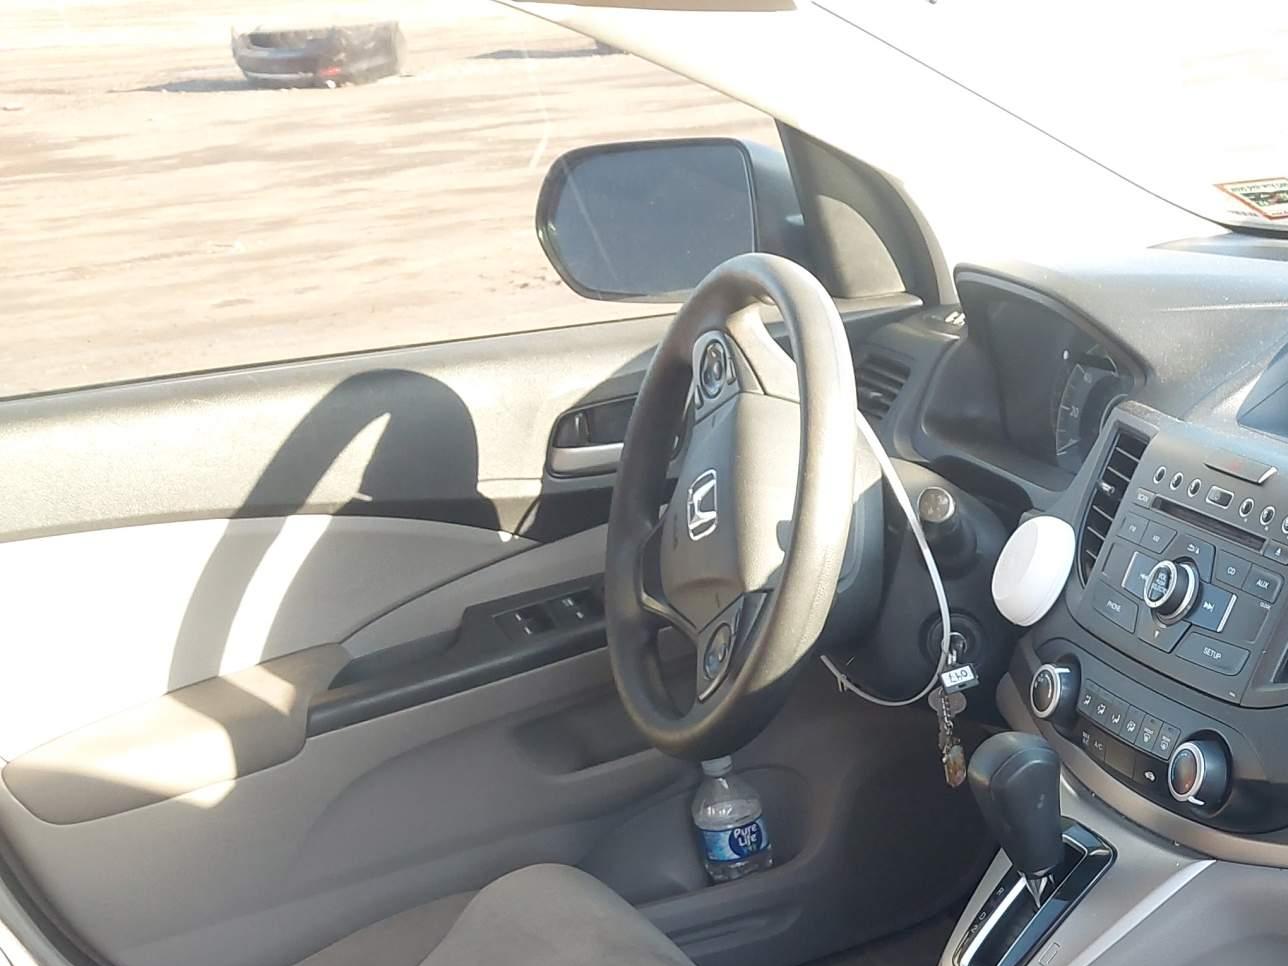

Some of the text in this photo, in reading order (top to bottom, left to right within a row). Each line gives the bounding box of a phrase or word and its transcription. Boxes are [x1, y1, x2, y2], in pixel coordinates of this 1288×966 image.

[1227, 566, 1236, 576] CD
[1256, 579, 1270, 590] AUX
[1203, 647, 1221, 660] SETUP
[733, 823, 757, 839] Pure
[738, 833, 757, 848] Life
